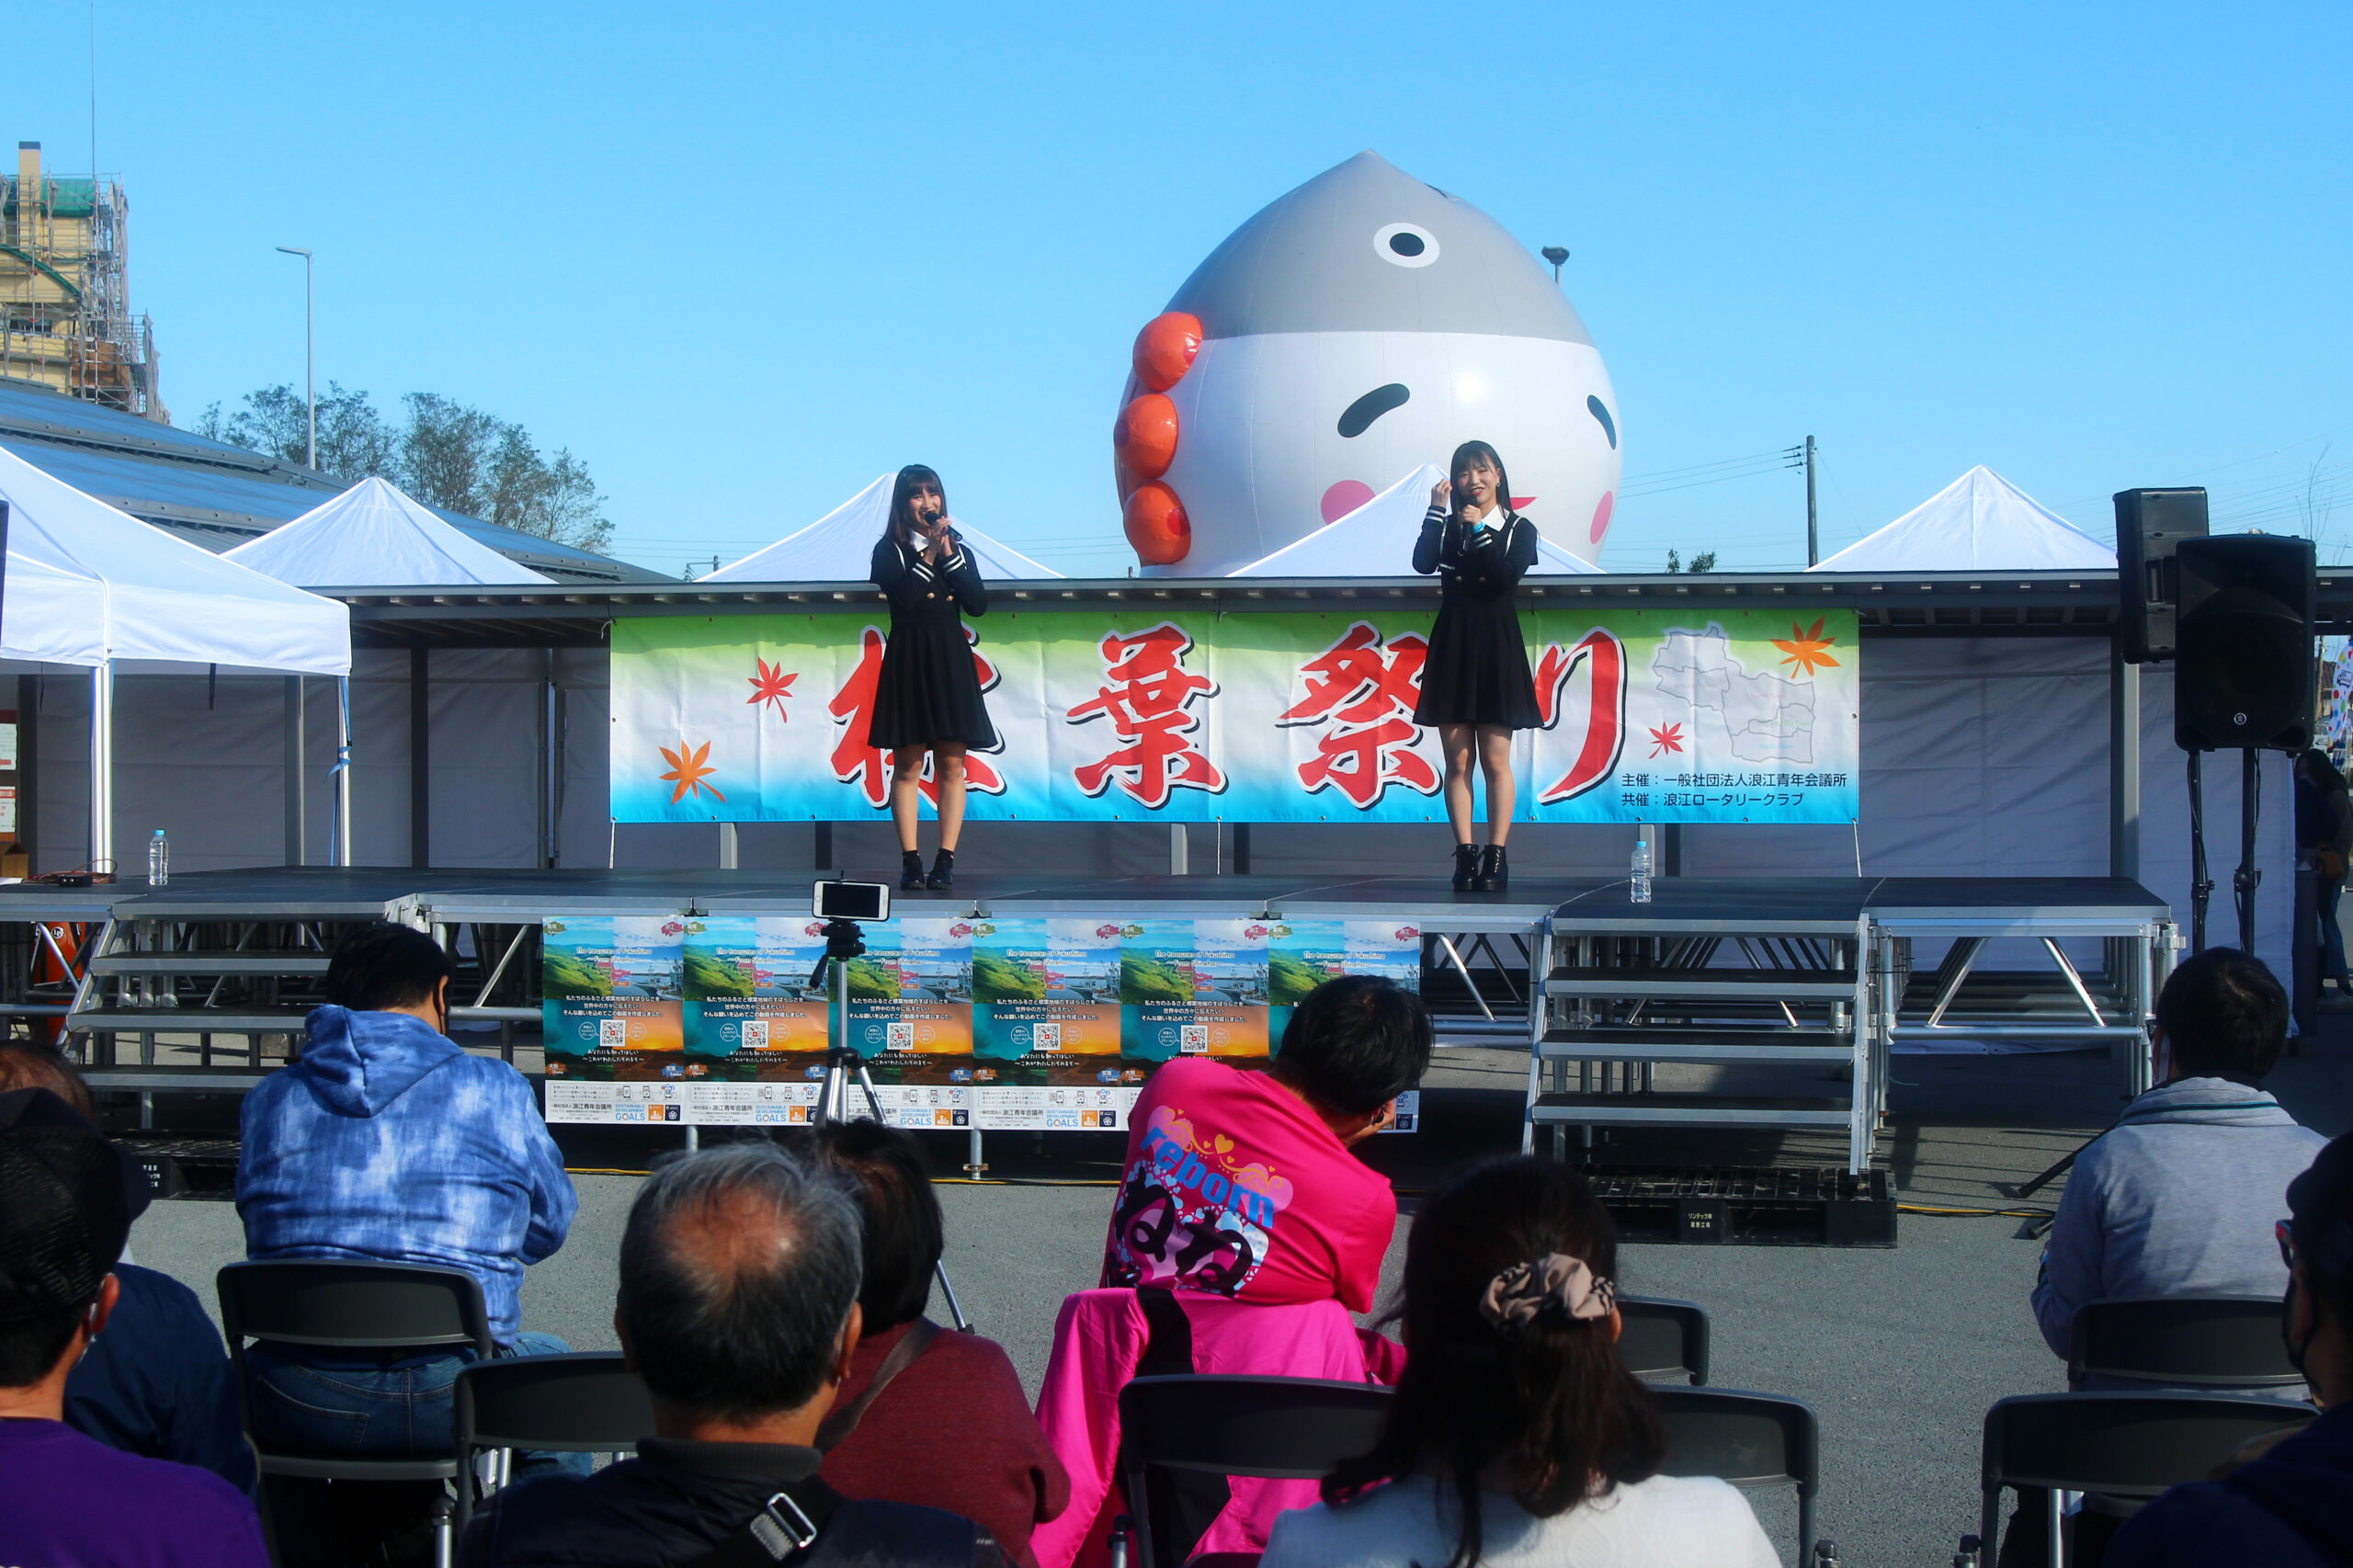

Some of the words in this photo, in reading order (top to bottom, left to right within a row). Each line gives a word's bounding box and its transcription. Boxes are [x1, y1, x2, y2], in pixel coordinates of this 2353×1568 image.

[1621, 793, 1804, 807] 共催：浪江ロータリークラブ
[614, 1113, 644, 1121] GOALS
[901, 1118, 931, 1126] GOALS
[1140, 1126, 1274, 1229] reborn
